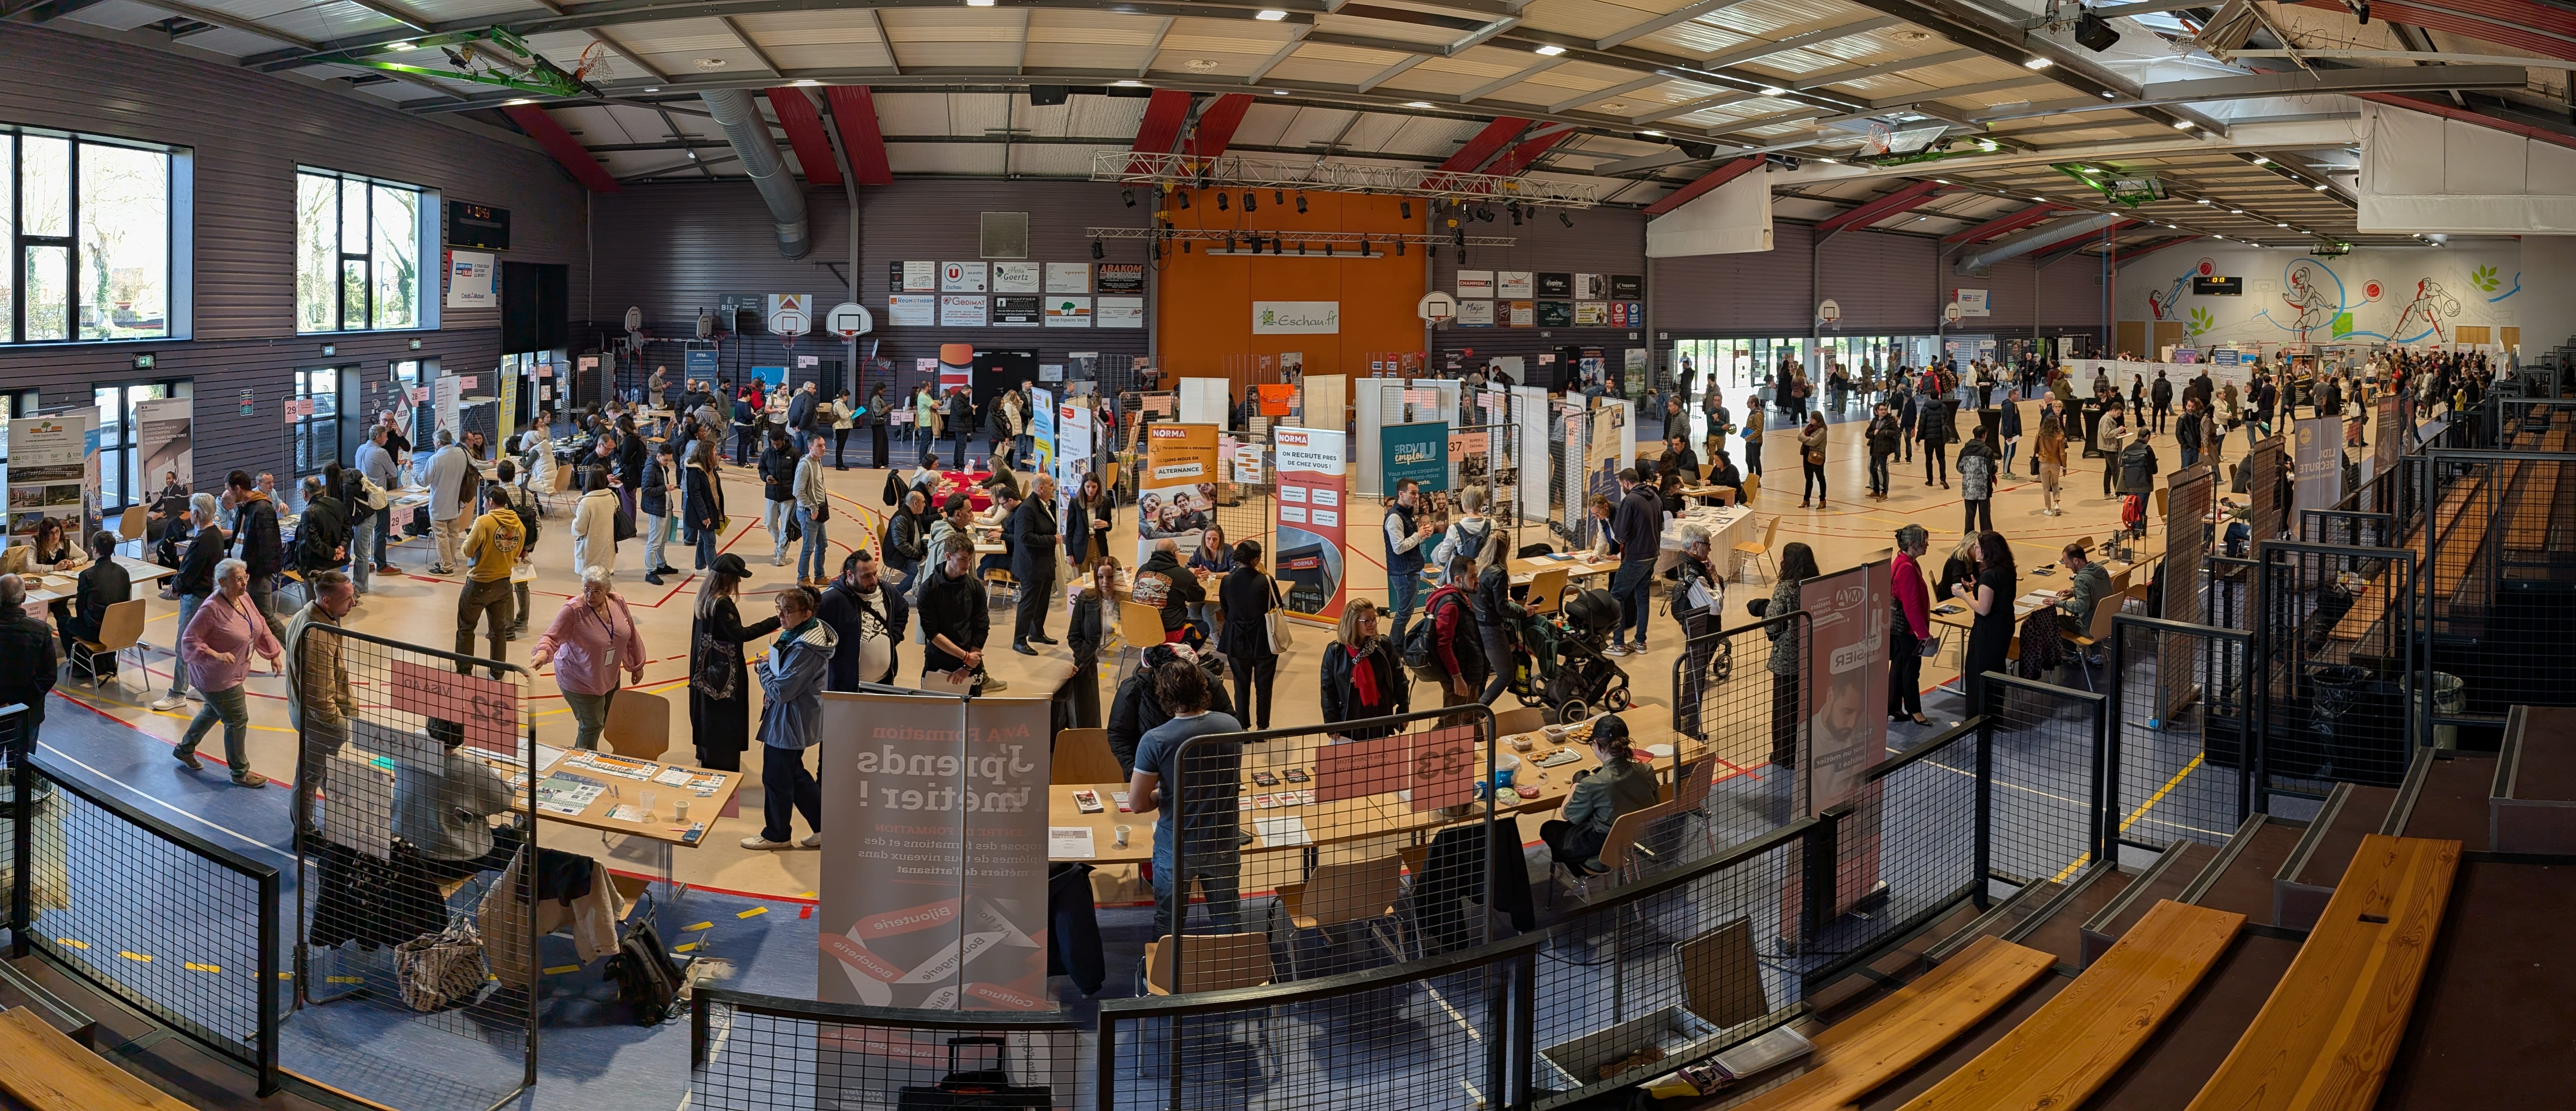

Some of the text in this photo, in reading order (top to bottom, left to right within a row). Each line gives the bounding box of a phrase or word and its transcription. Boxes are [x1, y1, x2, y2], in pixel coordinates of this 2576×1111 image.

[949, 269, 959, 278] U
[1278, 310, 1337, 326] Eschau.fr
[287, 406, 296, 414] 29
[1153, 429, 1185, 438] NORMA
[1569, 427, 1574, 436] 46
[1279, 434, 1307, 443] NORMA
[1400, 443, 1421, 454] RDV
[1420, 442, 1436, 459] U
[1449, 441, 1462, 452] 37
[1395, 449, 1426, 465] emploi
[1417, 467, 1440, 476] coopérer
[391, 517, 399, 527] 29
[550, 799, 584, 808] volontaire
